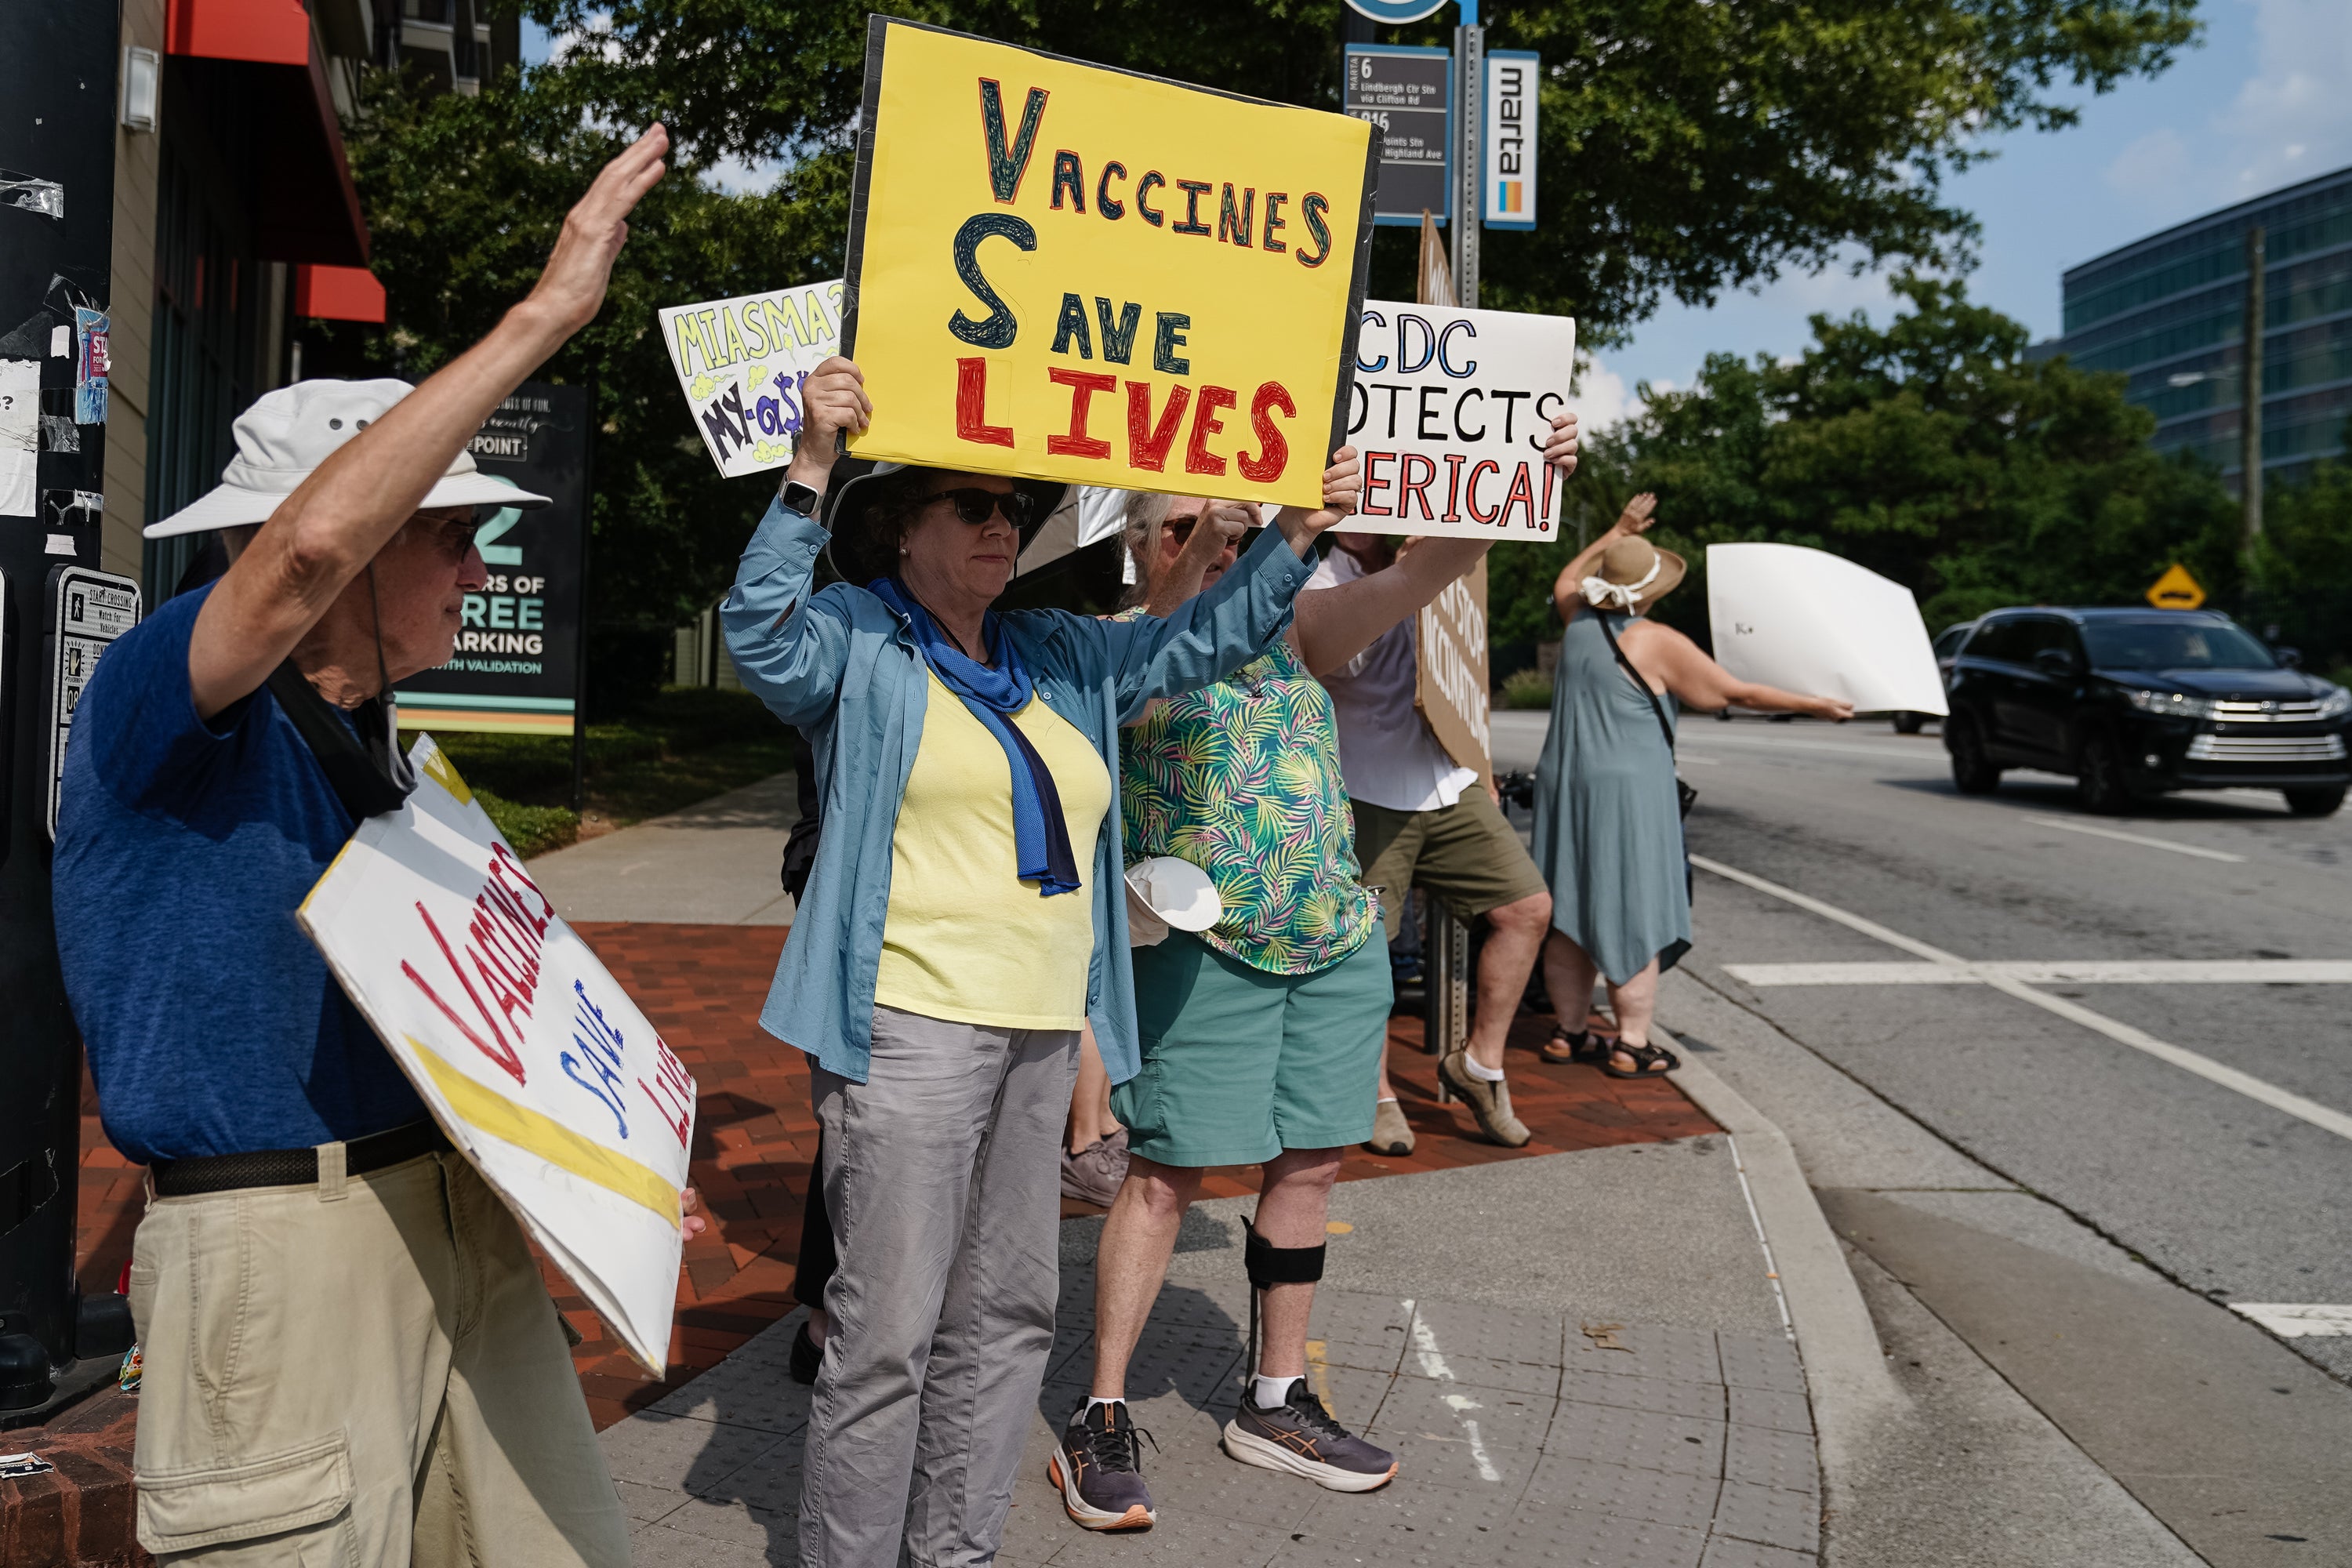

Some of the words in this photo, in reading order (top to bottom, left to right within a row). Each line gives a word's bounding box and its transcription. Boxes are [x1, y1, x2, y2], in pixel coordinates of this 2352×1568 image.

[1349, 56, 1359, 91] MARTA
[1361, 57, 1372, 79] 6
[1360, 82, 1404, 95] Lindbergh
[1406, 84, 1420, 94] Ctr
[1421, 84, 1436, 95] Stn
[1360, 93, 1374, 103] via
[1376, 94, 1406, 105] Clifton
[1407, 96, 1420, 105] Rd
[1499, 67, 1523, 175] marta
[1410, 136, 1424, 147] Stn
[1385, 148, 1424, 160] Highland
[1425, 150, 1443, 159] Ave
[1356, 310, 1477, 378] CDC
[956, 357, 1296, 484] LIVES
[474, 436, 522, 456] POINT
[473, 474, 523, 566] 2
[514, 575, 546, 594] OF
[89, 589, 105, 604] START
[107, 593, 132, 609] CROSSING
[99, 610, 111, 622] Watch
[1455, 576, 1485, 666] STOP
[100, 622, 118, 636] Vehicles
[466, 659, 543, 674] VALIDATION
